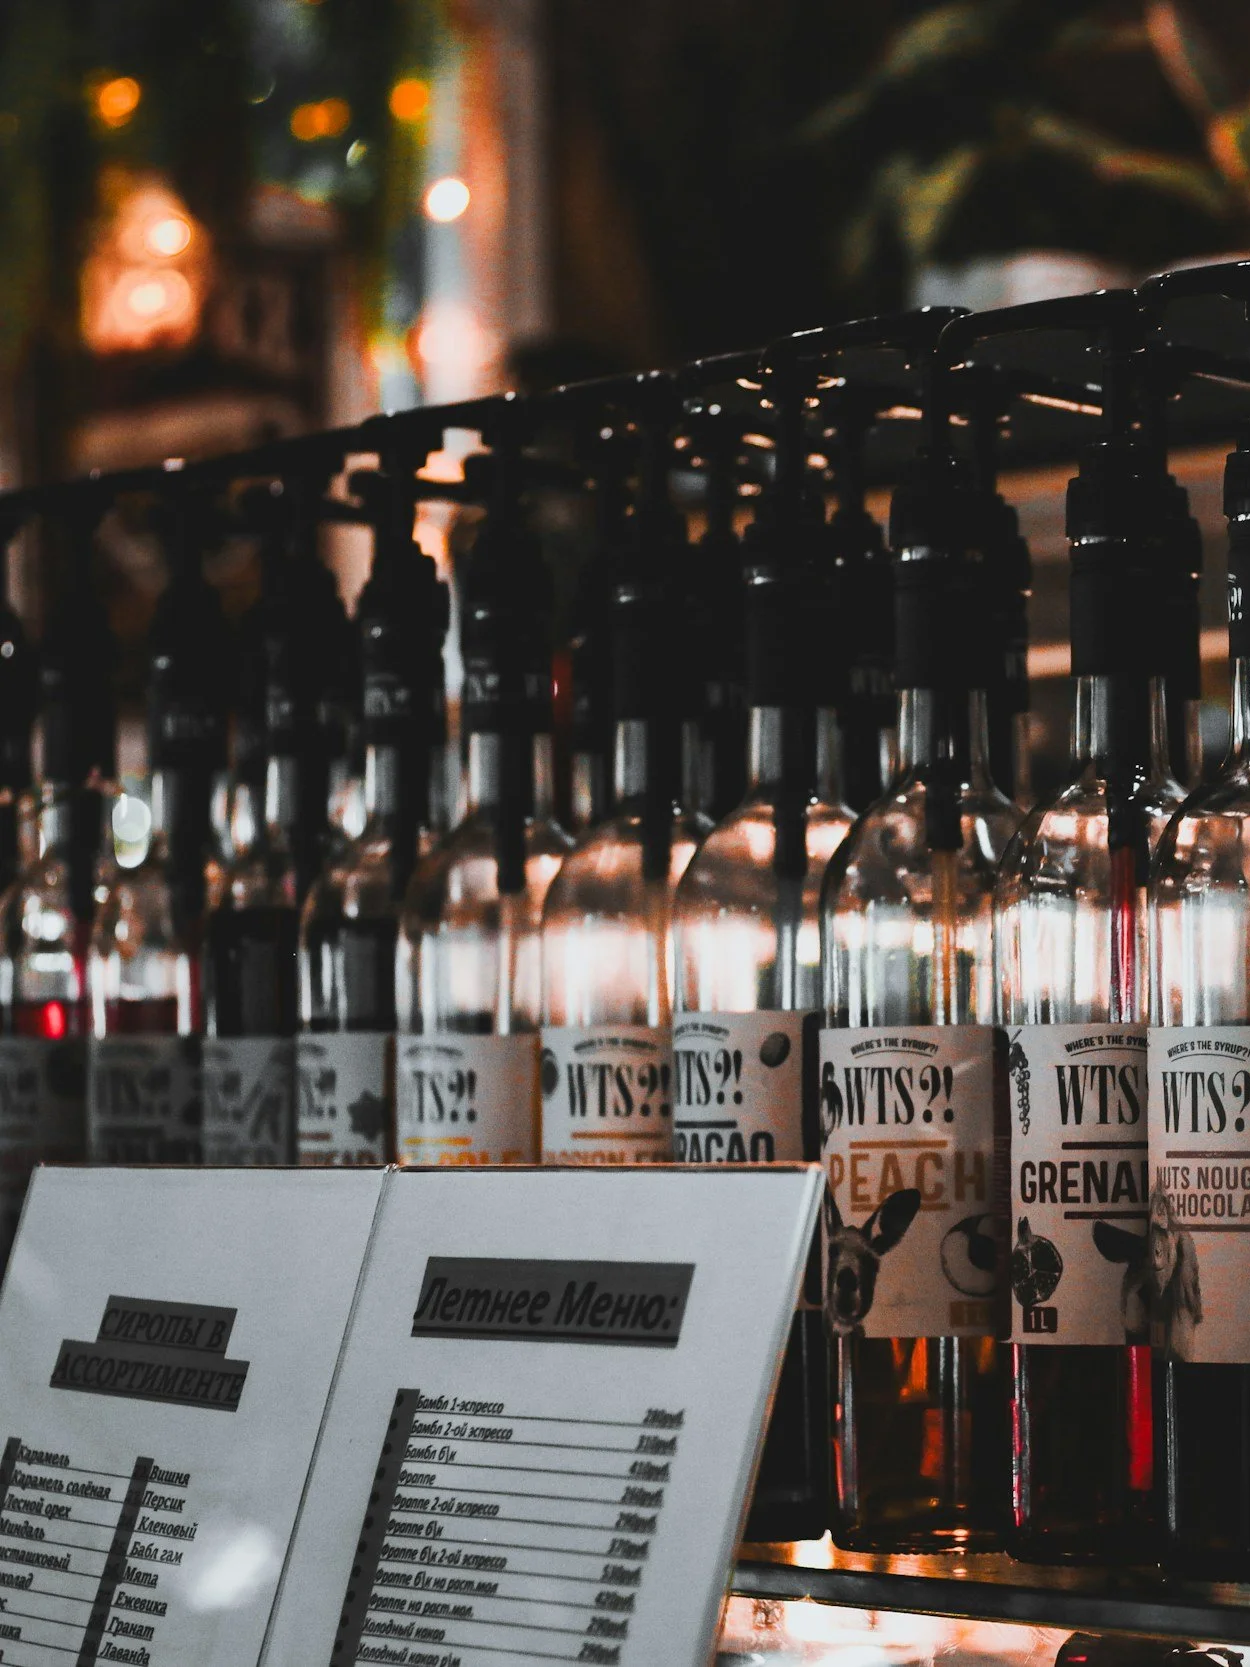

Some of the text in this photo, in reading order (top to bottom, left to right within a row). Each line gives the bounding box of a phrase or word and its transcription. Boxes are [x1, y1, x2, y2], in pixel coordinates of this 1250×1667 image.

[884, 1038, 900, 1047] THE
[1065, 1036, 1104, 1053] WHERE'S
[1106, 1035, 1124, 1045] THE
[1167, 1041, 1195, 1058] WHERE'S
[1197, 1040, 1212, 1050] THE
[567, 1062, 672, 1118] WTS?!
[844, 1065, 954, 1125] WTS?!
[1055, 1064, 1147, 1125] WTS
[829, 1150, 986, 1203] PEACH
[1156, 1166, 1190, 1190] NUTS
[414, 1277, 678, 1330] Летнее Меню:
[100, 1308, 227, 1349] СИРОПЫ В
[1029, 1310, 1049, 1330] 1L
[51, 1353, 247, 1401] АССОРТИМЕНТЕ
[18, 1446, 70, 1466] Карамель
[12, 1470, 64, 1491] Карамель
[66, 1481, 112, 1500] солёная
[150, 1465, 191, 1485] Вишня
[400, 1469, 436, 1486] Фраппе
[44, 1503, 71, 1520] орех
[144, 1491, 186, 1512] Персик
[138, 1516, 198, 1538] Кленовый
[129, 1541, 158, 1559] Бабл
[160, 1549, 183, 1564] гам
[123, 1565, 159, 1586] Мята
[433, 1577, 448, 1589] на
[115, 1591, 167, 1614] Ежевика
[407, 1600, 422, 1612] на
[108, 1616, 155, 1638] Гранат
[362, 1617, 417, 1635] Холодный
[413, 1626, 446, 1642] какао
[101, 1642, 150, 1665] Лаванда
[356, 1642, 409, 1662] Холодный
[409, 1652, 440, 1667] какао
